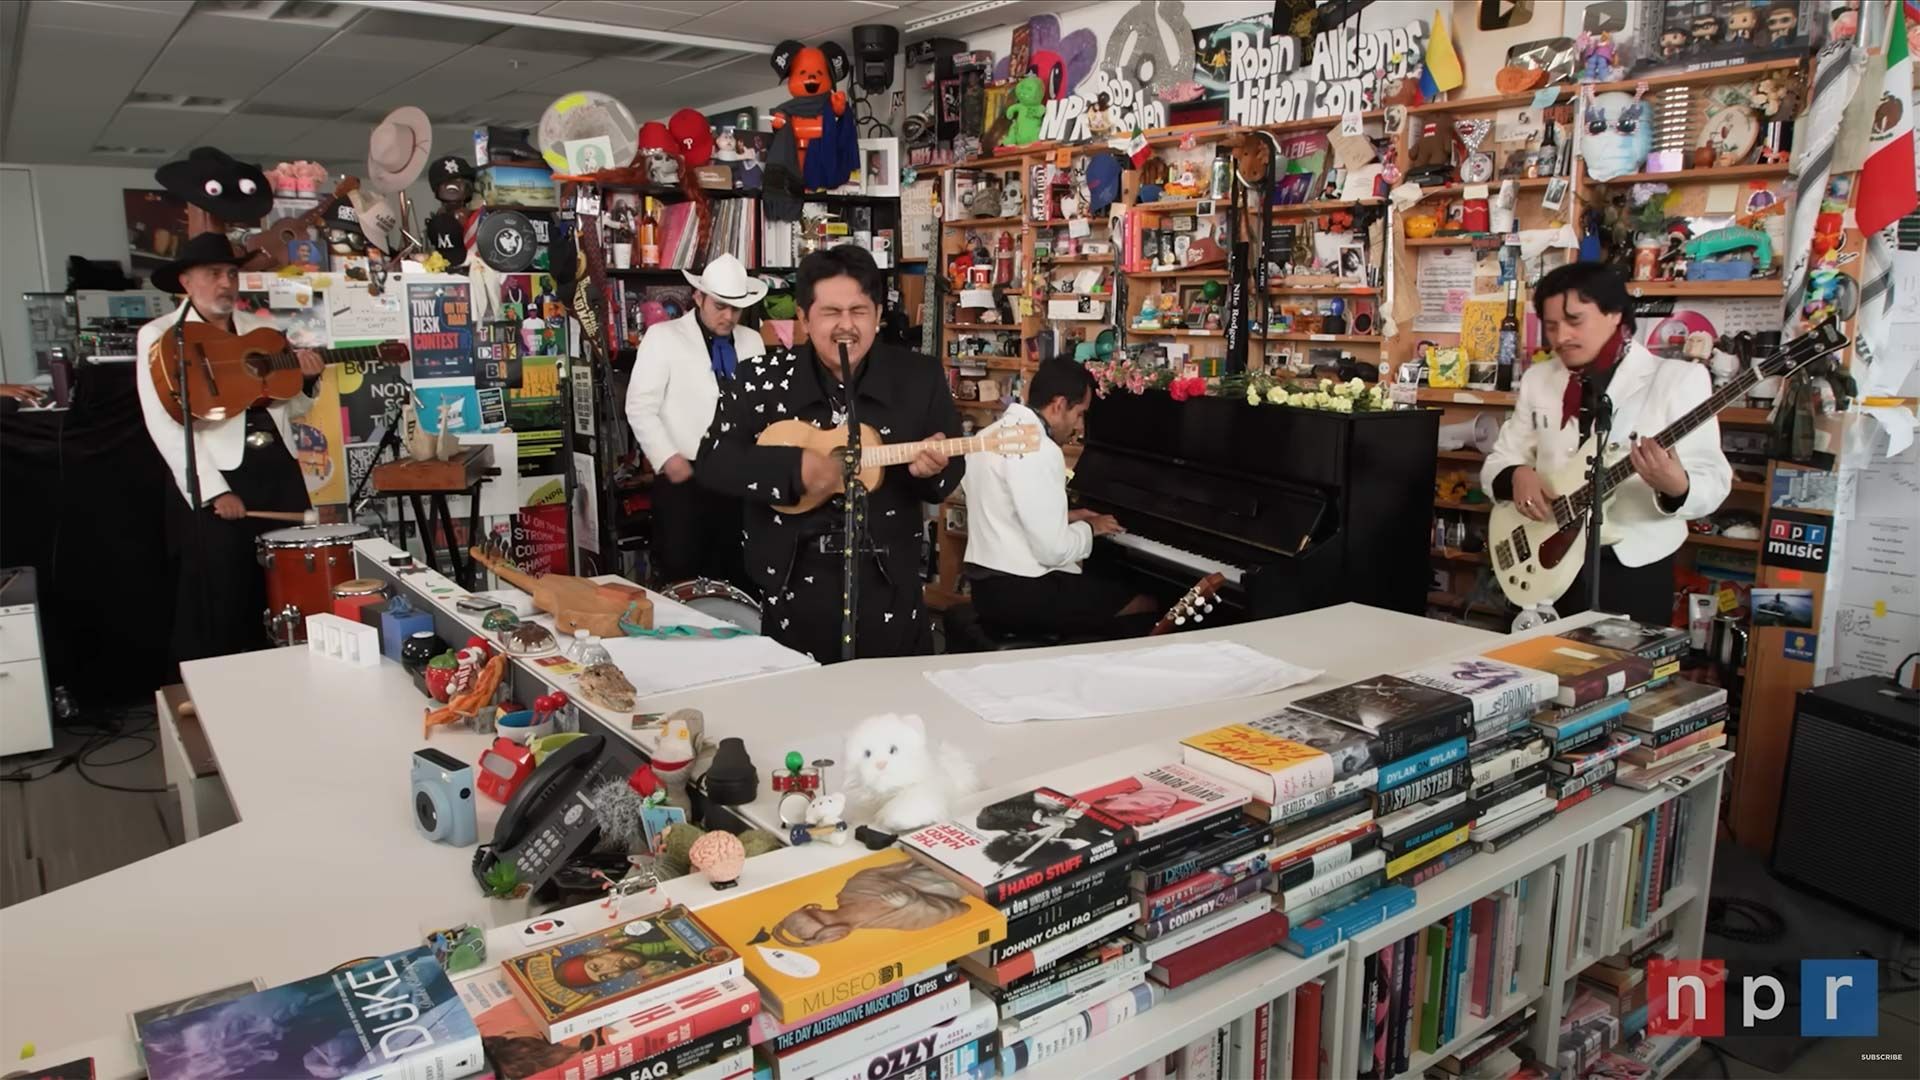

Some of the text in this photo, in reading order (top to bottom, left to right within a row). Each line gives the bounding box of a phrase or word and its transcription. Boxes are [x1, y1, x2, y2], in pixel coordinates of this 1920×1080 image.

[1230, 28, 1294, 82] Robin
[1098, 66, 1133, 108] Bob
[1230, 71, 1308, 126] Hilton
[1040, 95, 1098, 141] NPR
[1109, 90, 1166, 133] Boilen
[683, 137, 693, 150] P
[438, 234, 454, 248] M
[411, 299, 436, 316] TINY
[1229, 282, 1241, 350] Nile Rodgers
[413, 316, 440, 333] DESK
[414, 332, 459, 350] CONTEST
[545, 487, 564, 502] NPR
[1775, 523, 1820, 540] npr
[1768, 540, 1823, 560] music
[1502, 683, 1534, 713] PRINCE
[1660, 733, 1671, 742] The
[1670, 723, 1695, 740] FRANK
[1387, 748, 1457, 784] DYLAN ON DYLAN
[1144, 768, 1226, 802] DAVID BOWIE
[1394, 768, 1453, 809] SPRINGSTEEN
[1281, 786, 1337, 816] BEATLES STONES
[912, 832, 939, 849] THE
[924, 828, 965, 850] HARD
[937, 823, 980, 847] STUFF
[1091, 840, 1115, 855] WAYNE
[1089, 846, 1118, 865] KRAMER
[1007, 873, 1044, 896] HARD
[1046, 854, 1083, 878] STUFF
[1309, 864, 1365, 898] McCARTNEY
[1013, 885, 1063, 915] doe UNDER the
[1169, 887, 1239, 931] COUNTRY Soul
[1001, 933, 1043, 960] JOHNNY
[1045, 921, 1071, 939] CASH
[1072, 912, 1092, 927] FAQ
[1058, 958, 1100, 979] STEVE EARLE
[345, 959, 434, 1060] DUKE
[802, 973, 878, 1016] MUSEO
[777, 979, 938, 1051] THE DAY ALTERNATIVE MUSIC DIED Caress
[1261, 1005, 1268, 1016] WE
[939, 1032, 973, 1050] OSBOURNE
[947, 1028, 965, 1040] OZZY
[630, 1061, 668, 1080] FAQ
[867, 1034, 938, 1080] OZZY
